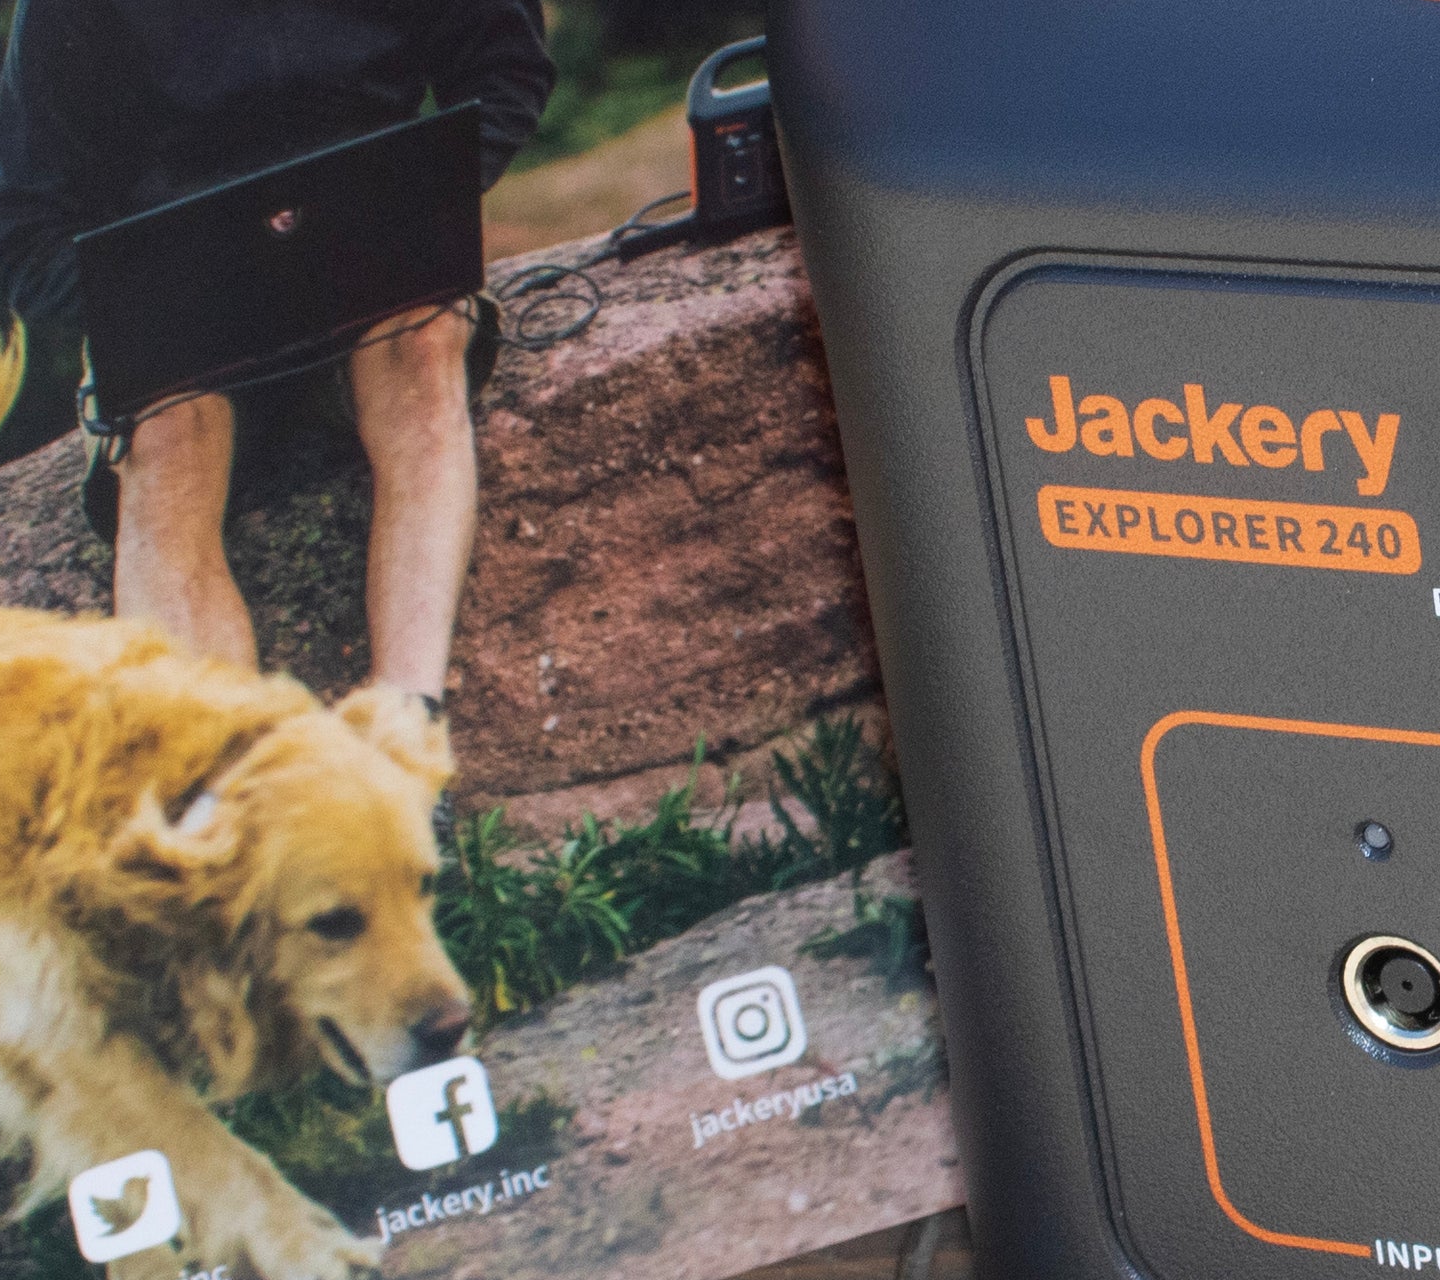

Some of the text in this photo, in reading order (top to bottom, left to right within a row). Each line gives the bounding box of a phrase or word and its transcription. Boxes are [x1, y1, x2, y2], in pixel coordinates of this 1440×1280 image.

[1024, 374, 1402, 498] Jackery
[1053, 498, 1404, 561] EXPLORER 240
[689, 1072, 858, 1150] jackeryusa
[375, 1163, 551, 1246] jackery.inc
